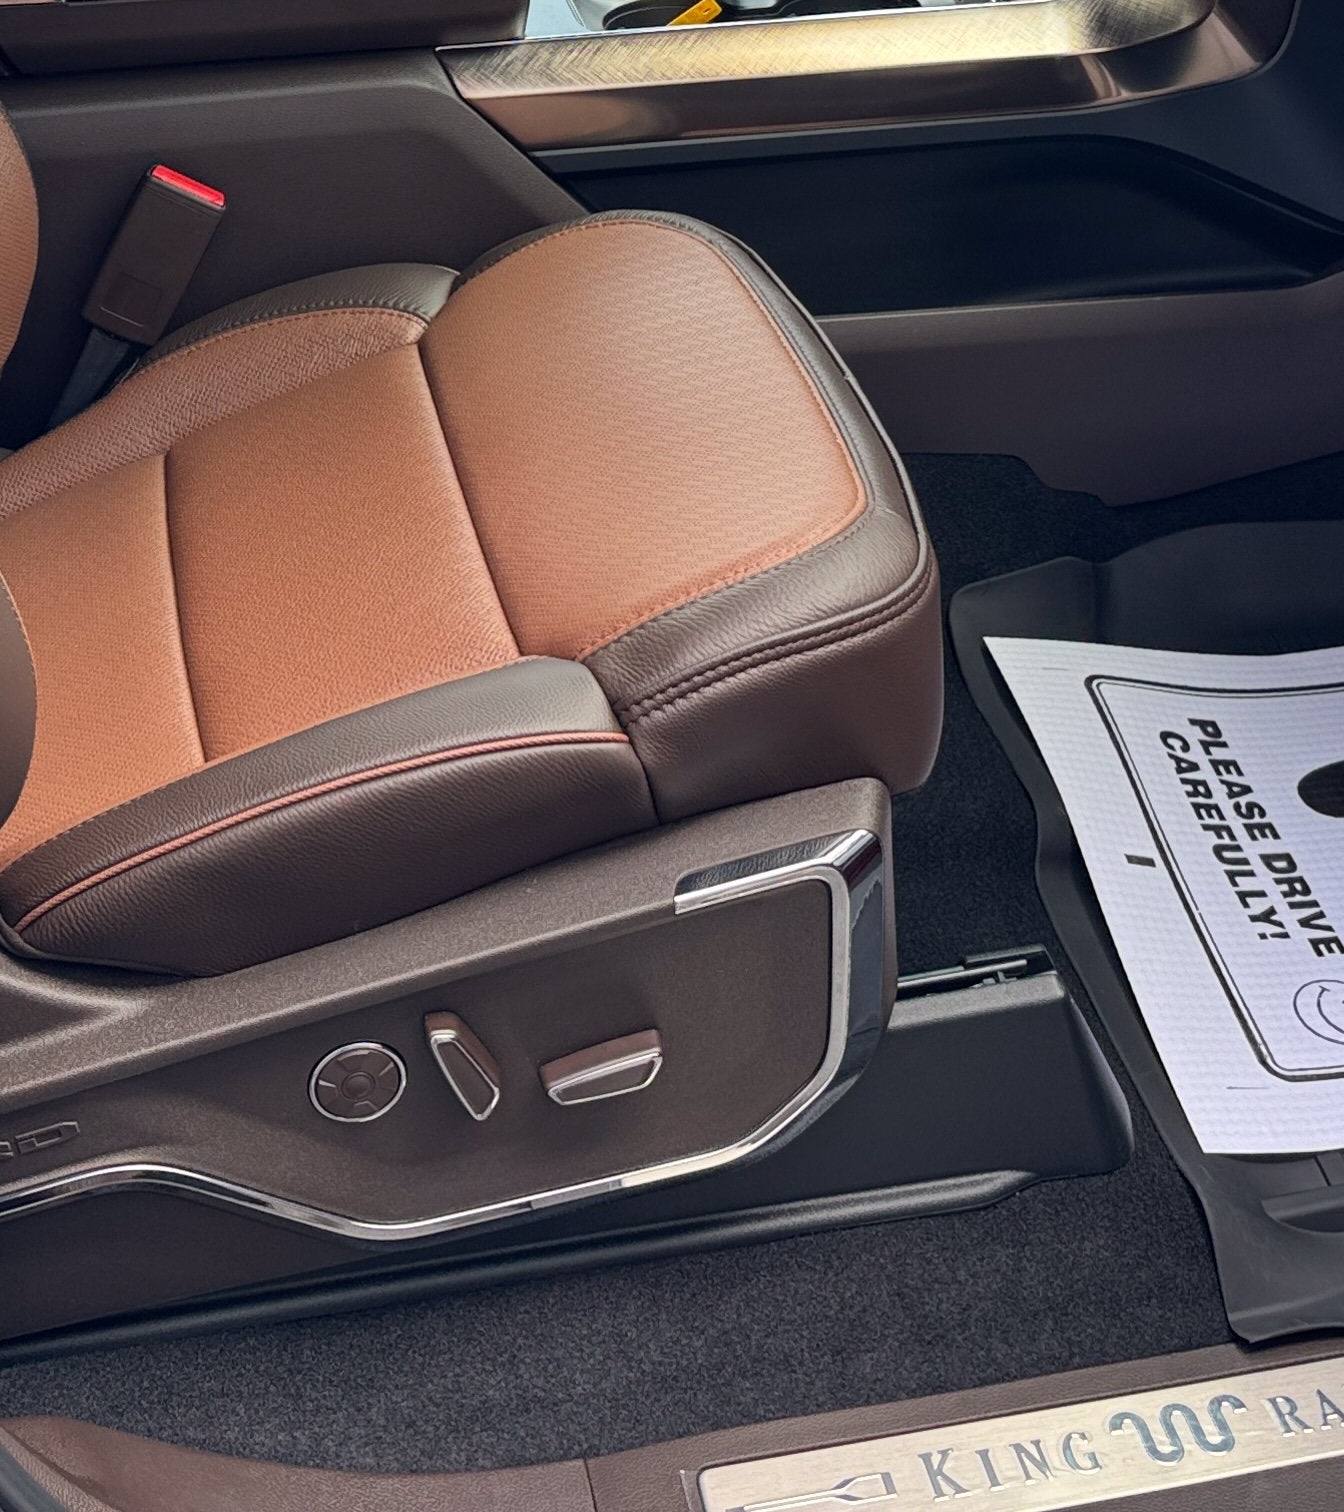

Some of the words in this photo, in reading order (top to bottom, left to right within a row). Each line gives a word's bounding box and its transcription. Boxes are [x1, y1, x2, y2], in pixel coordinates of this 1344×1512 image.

[1159, 730, 1291, 941] CAREFULLY!
[1187, 717, 1282, 842] PLEASE
[917, 1431, 1103, 1502] KING
